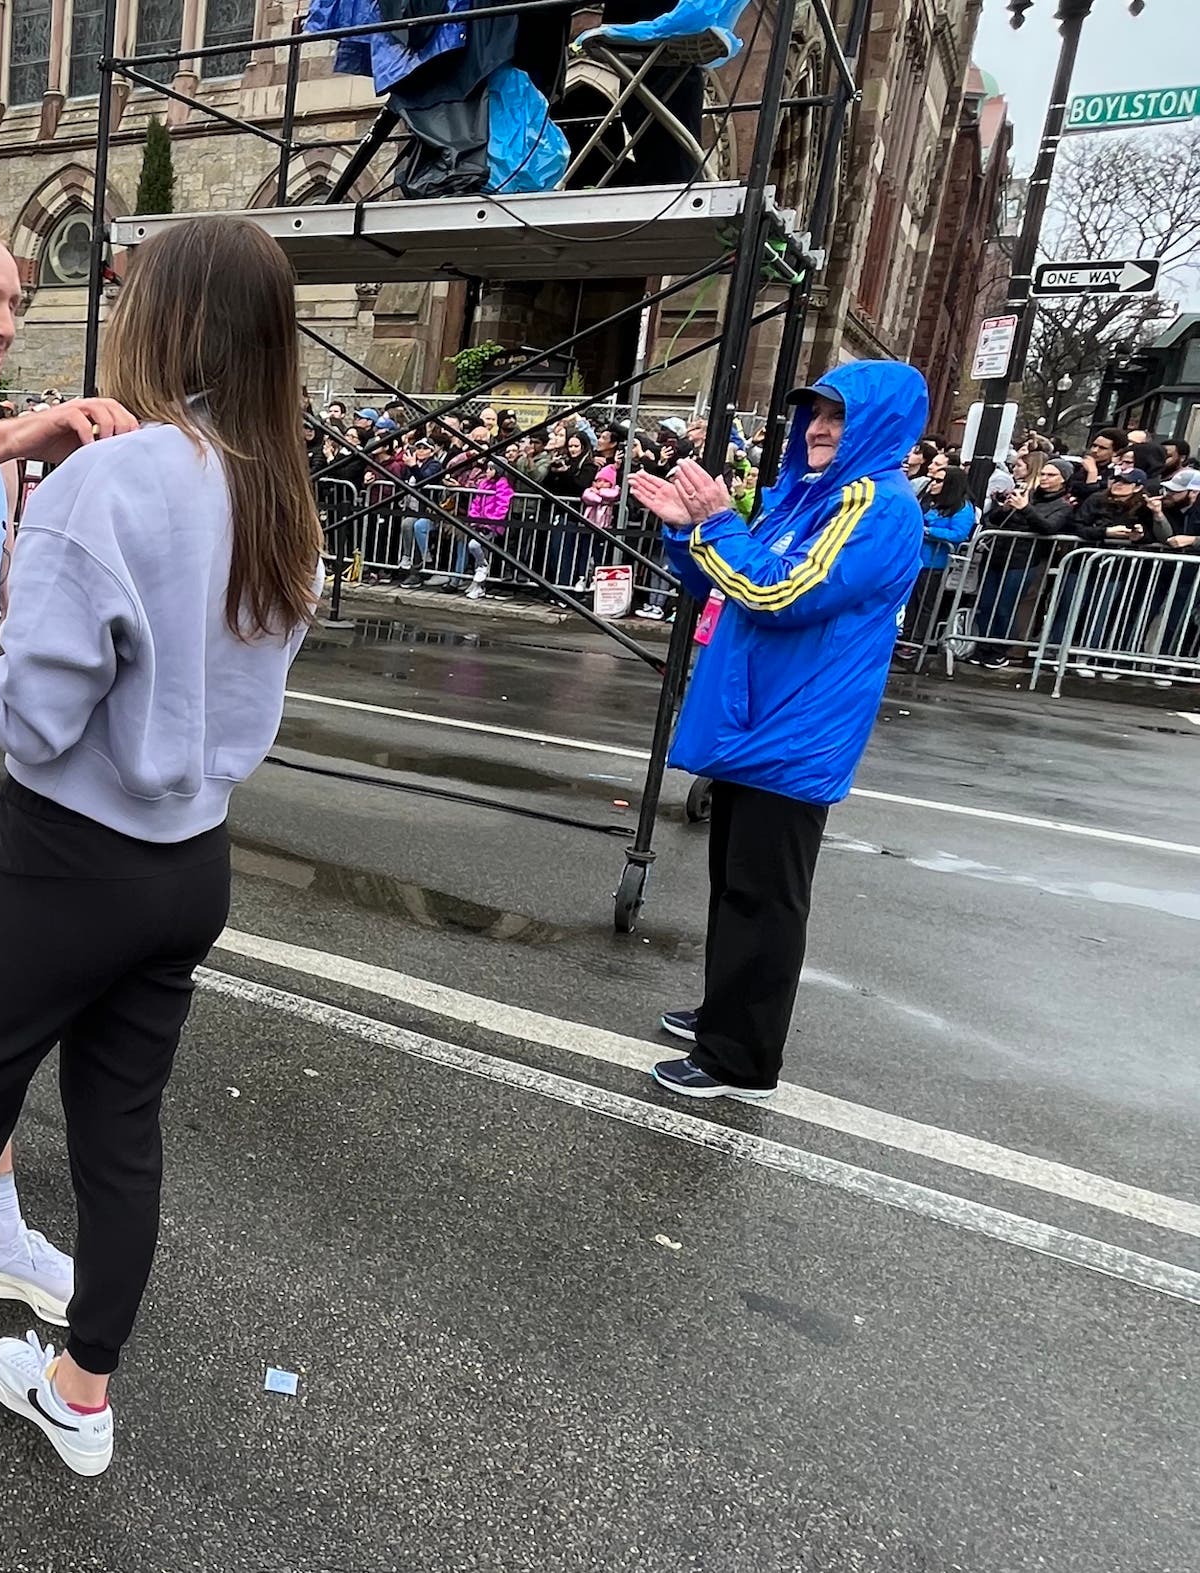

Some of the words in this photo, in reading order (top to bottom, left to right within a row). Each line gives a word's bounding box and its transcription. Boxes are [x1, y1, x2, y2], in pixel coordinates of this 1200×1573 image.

[1069, 89, 1198, 123] BOYLSTON
[1047, 272, 1079, 285] ONE
[1089, 271, 1122, 283] WAY
